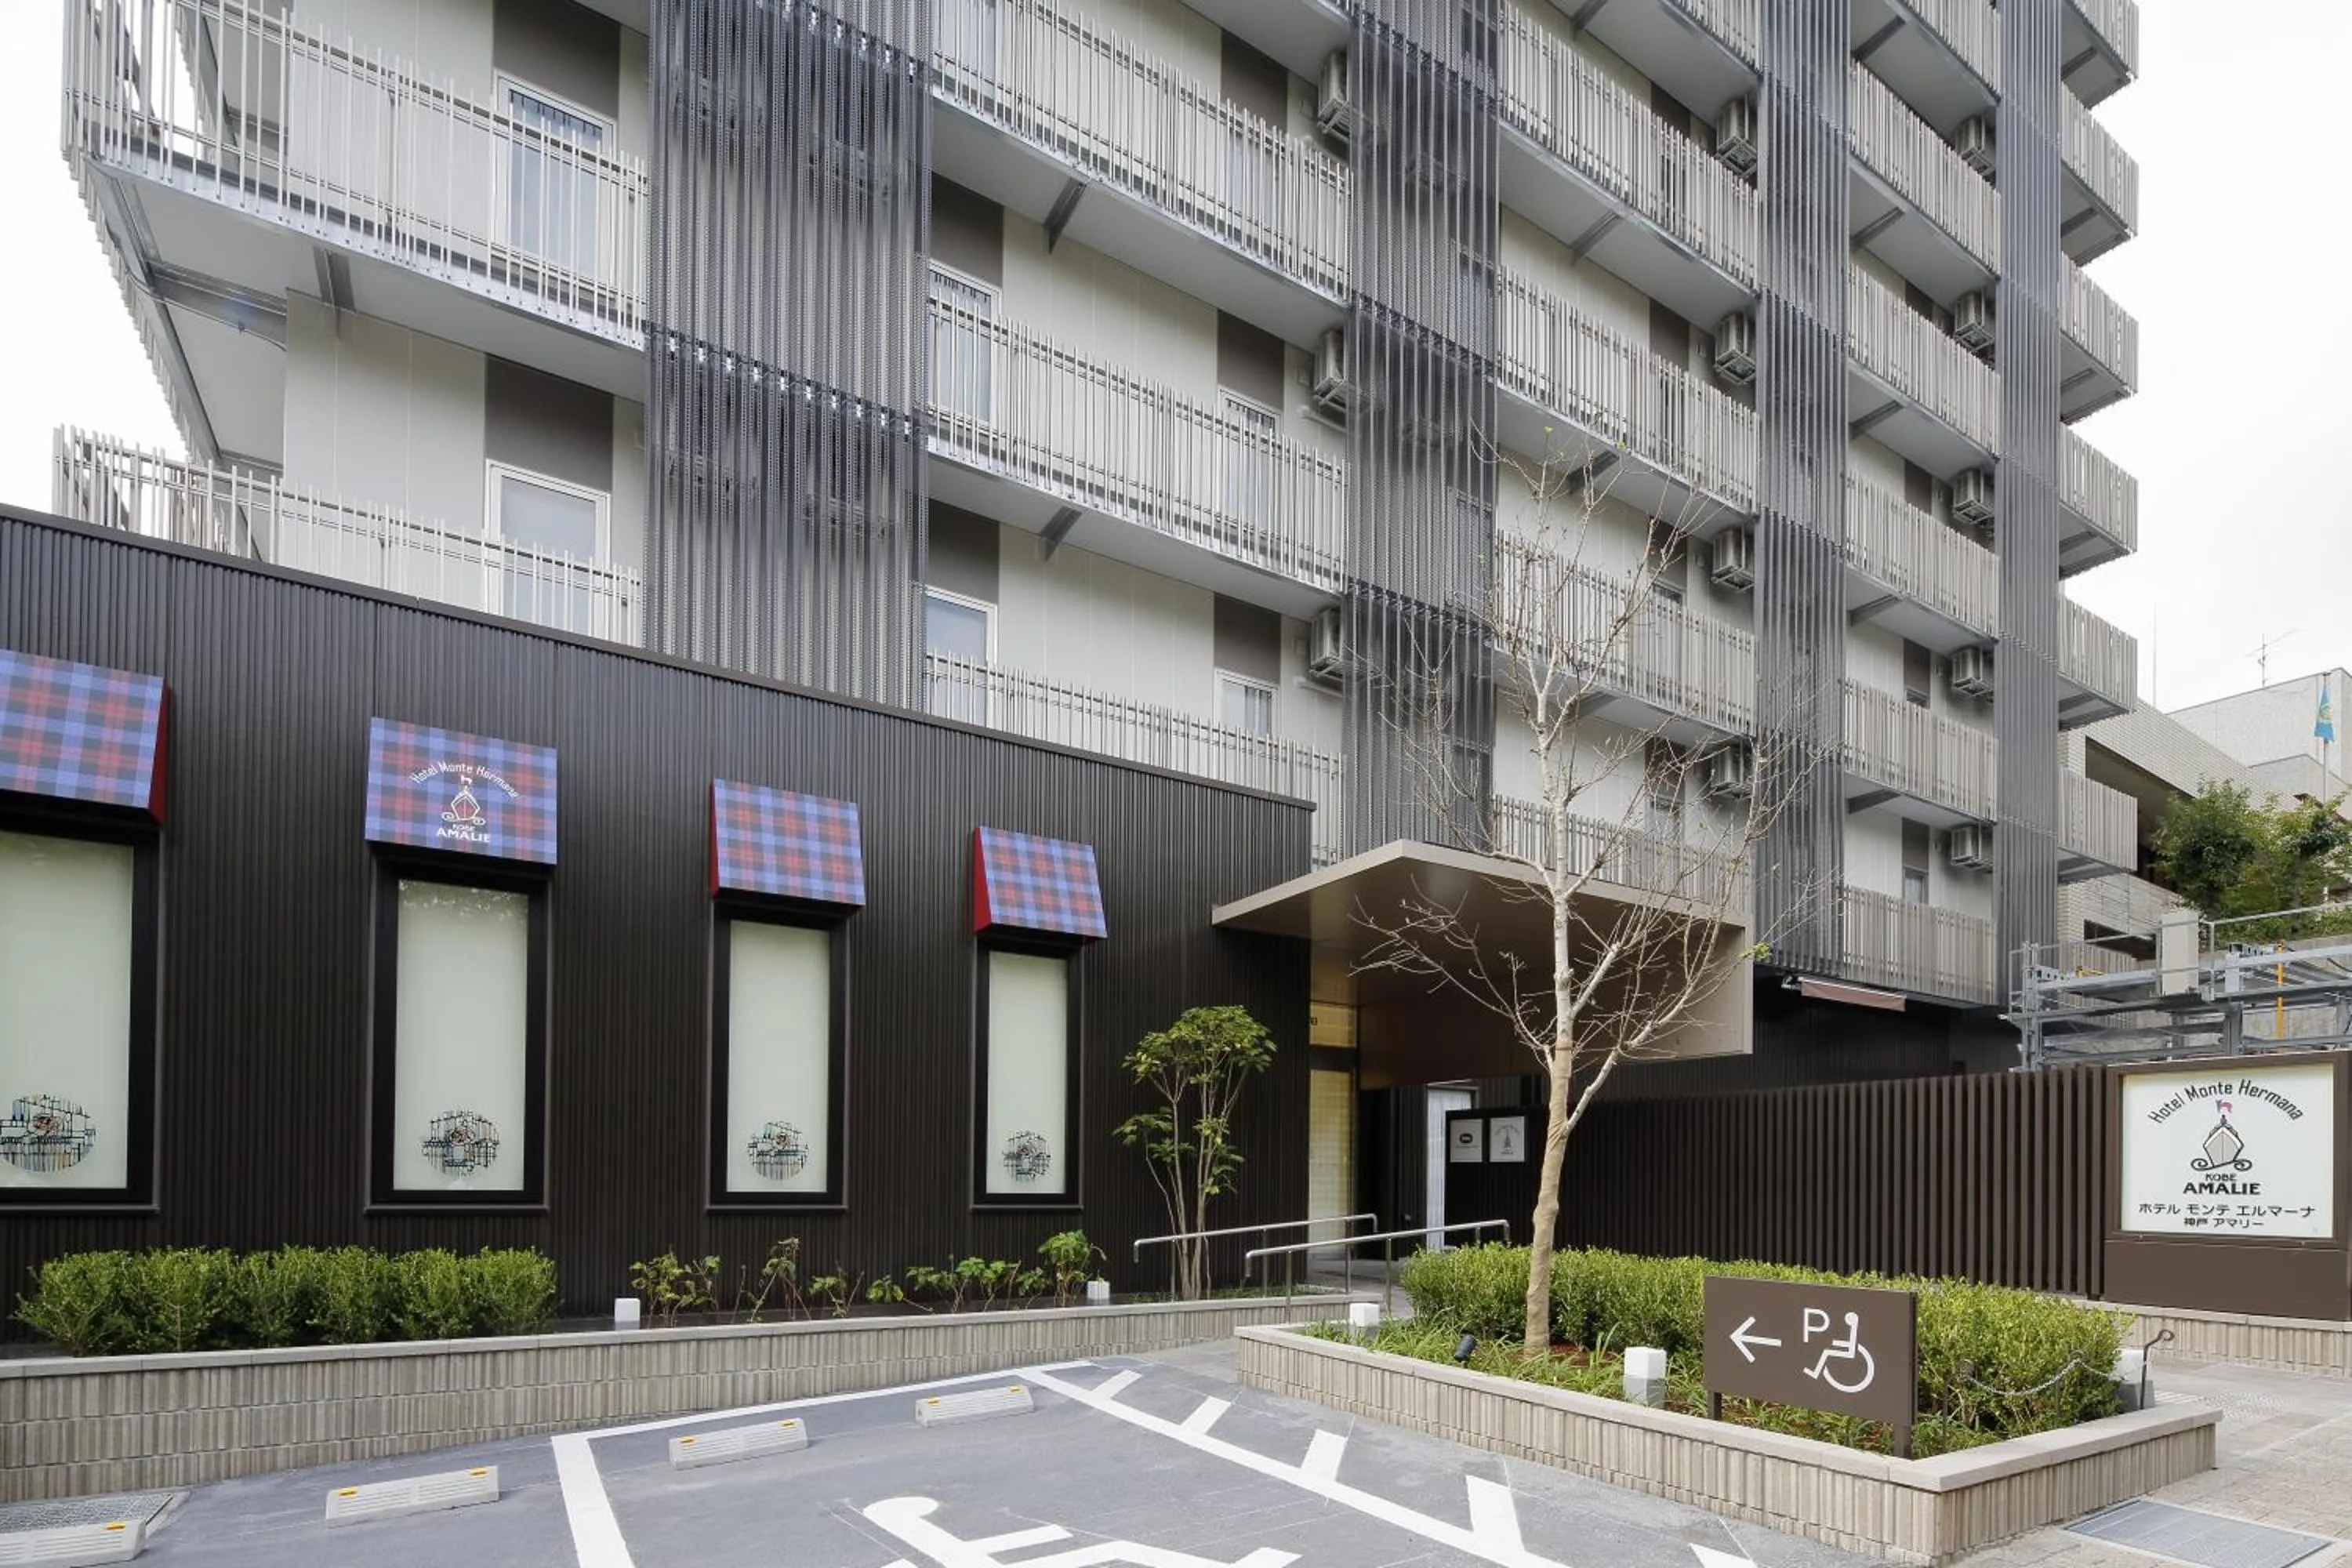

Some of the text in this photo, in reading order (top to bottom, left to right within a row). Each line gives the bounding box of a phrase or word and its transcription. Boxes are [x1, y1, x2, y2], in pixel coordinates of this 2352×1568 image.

[410, 764, 438, 783] Hotel
[437, 760, 474, 773] Monte
[436, 827, 491, 843] AMALIE
[2147, 1078, 2304, 1123] Hotel Monte Hermana
[2205, 1173, 2238, 1182] KOBE
[2183, 1182, 2262, 1196] AMALIE
[2139, 1203, 2316, 1218] ホテル モンテ エルマーナ
[2183, 1217, 2265, 1229] 神戸 アマリー
[1803, 1307, 1831, 1343] P
